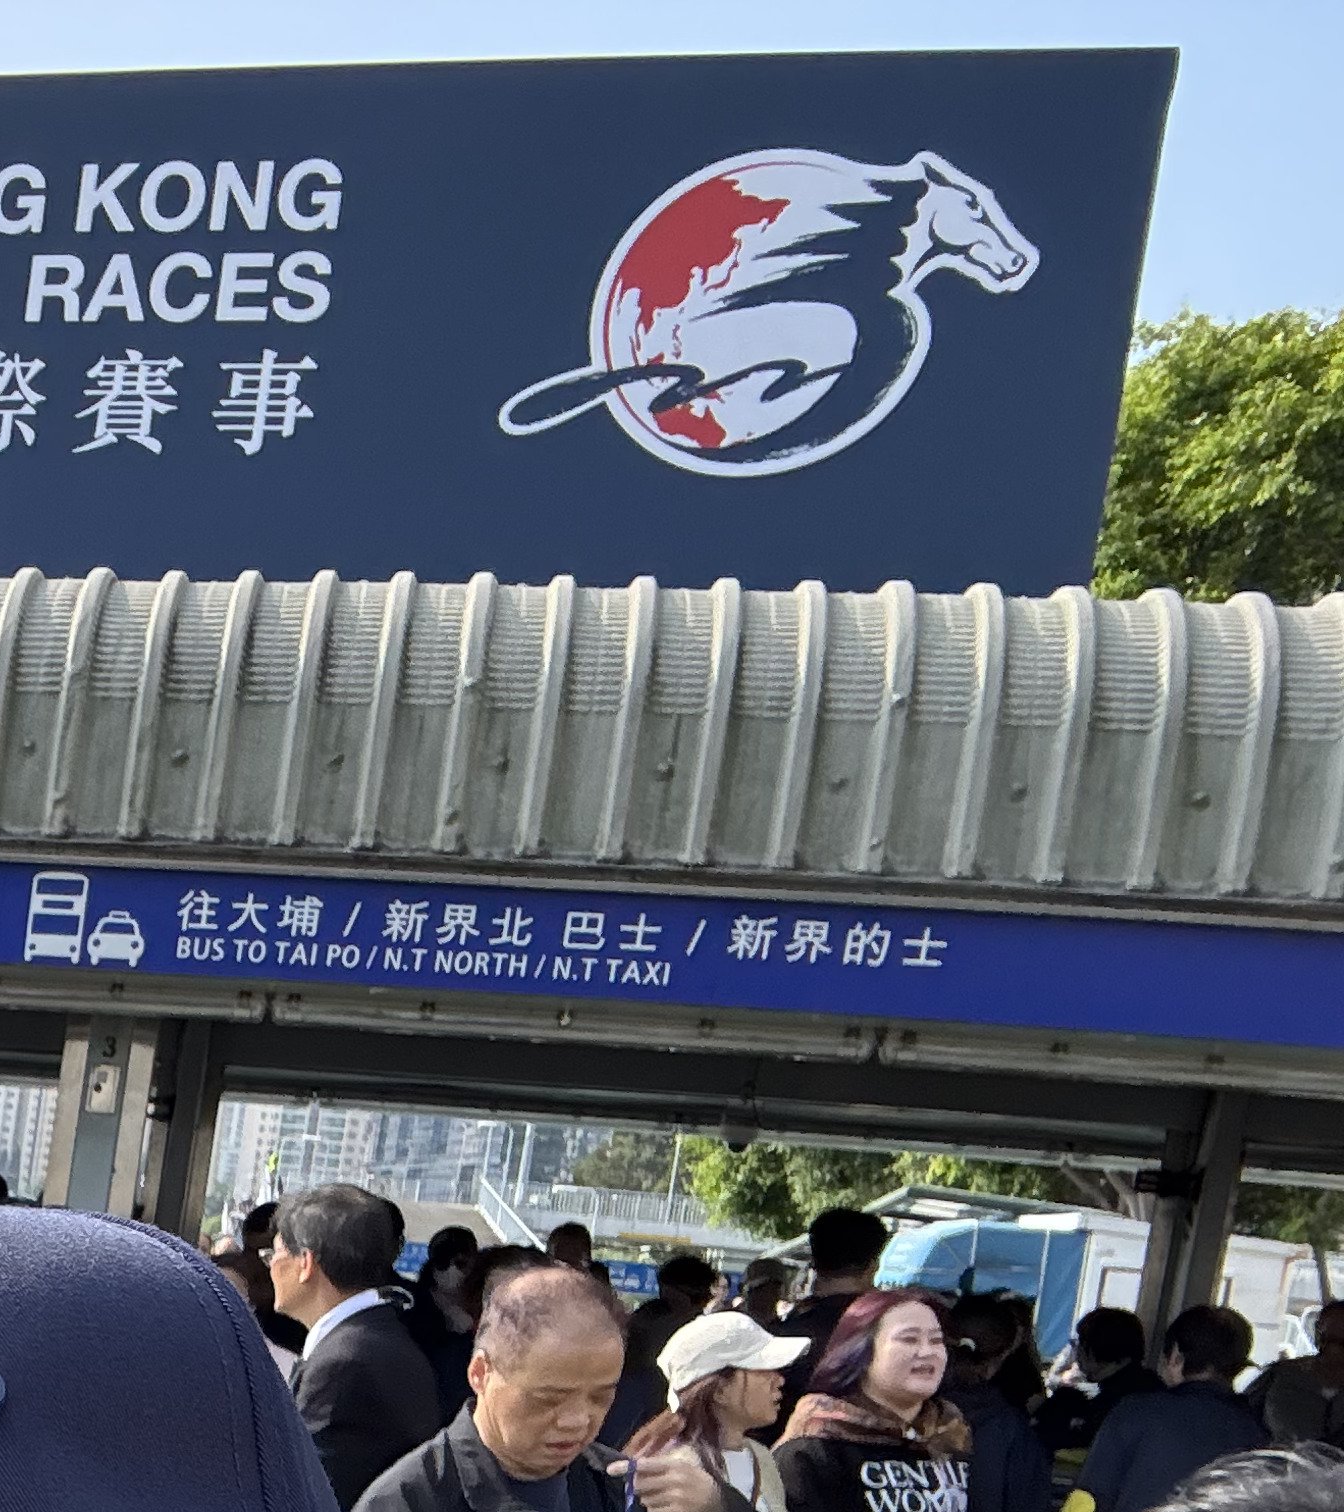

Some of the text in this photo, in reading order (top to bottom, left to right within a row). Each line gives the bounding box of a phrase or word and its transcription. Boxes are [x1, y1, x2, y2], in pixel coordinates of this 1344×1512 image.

[74, 157, 344, 234] KONG
[24, 250, 334, 324] RACES
[176, 888, 324, 938] 往大埔
[381, 898, 536, 947] 新界北
[562, 910, 663, 953] 巴士
[727, 914, 949, 969] 新界的士
[176, 935, 226, 962] BUS
[233, 938, 267, 964] TO
[274, 940, 318, 967] TAI
[325, 943, 360, 969] PO
[383, 947, 428, 973] N.T
[434, 949, 528, 978] NORTH
[552, 956, 598, 982] N.T
[606, 958, 672, 987] TAXI
[102, 1035, 117, 1058] 3
